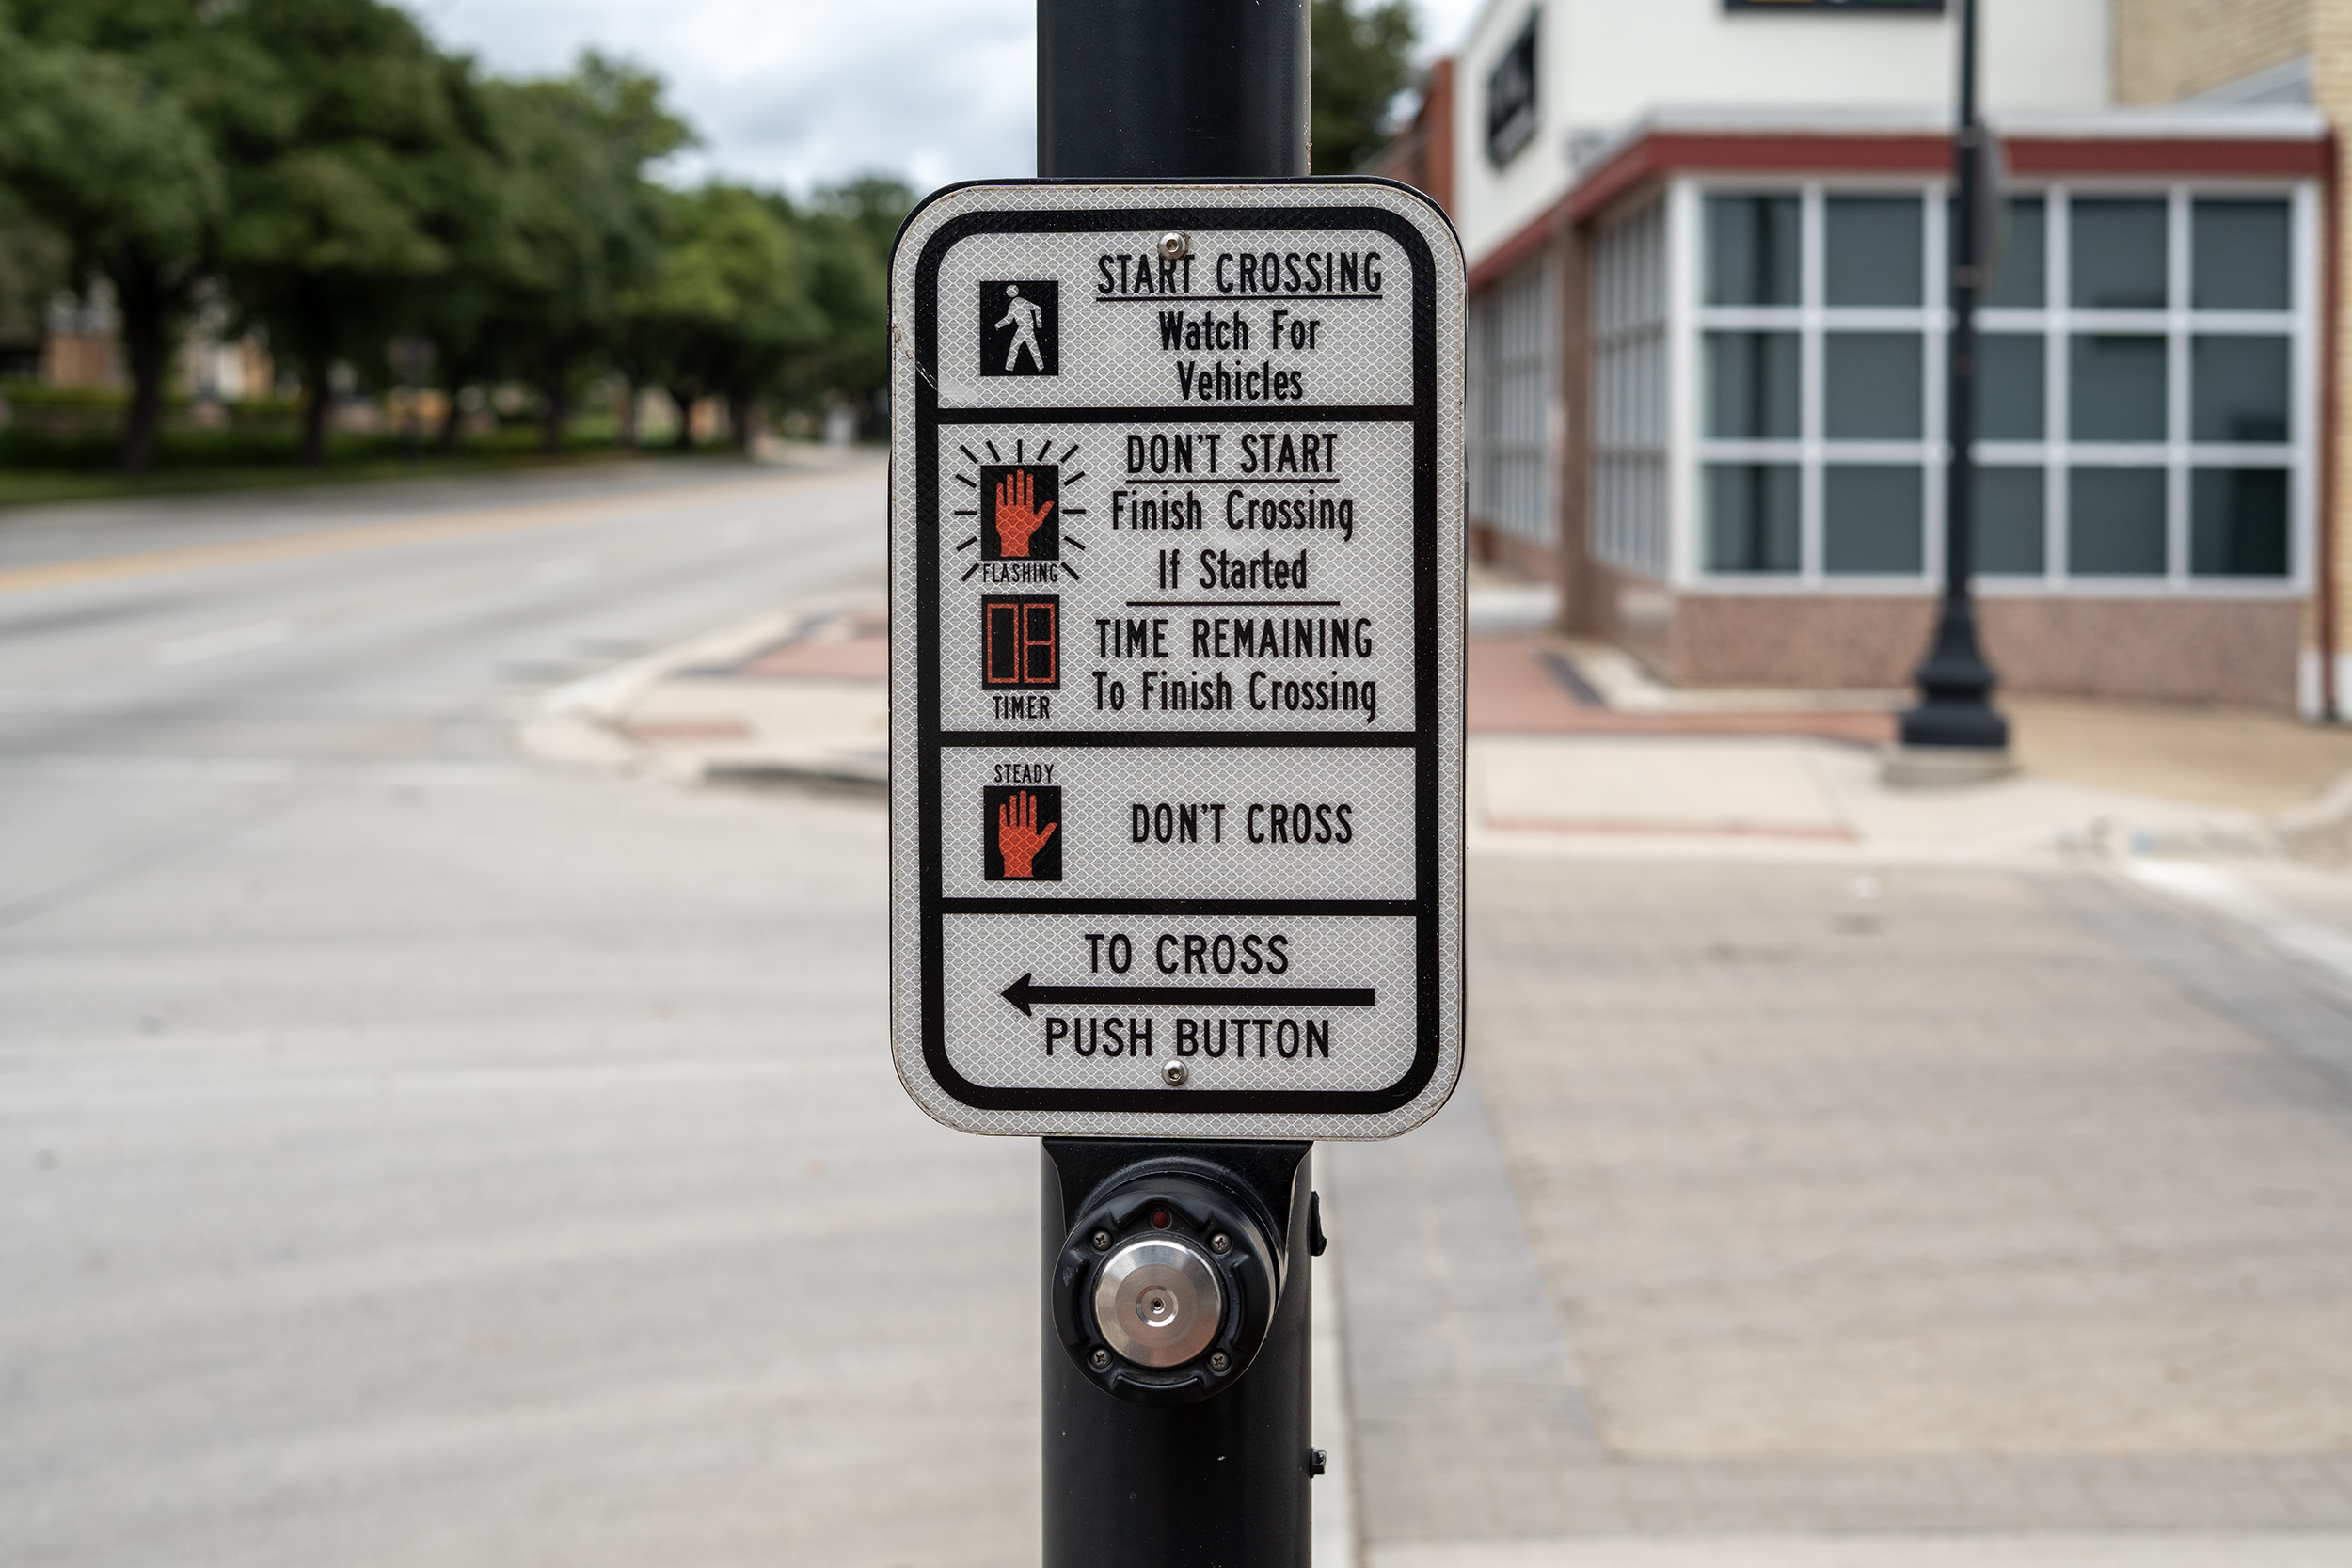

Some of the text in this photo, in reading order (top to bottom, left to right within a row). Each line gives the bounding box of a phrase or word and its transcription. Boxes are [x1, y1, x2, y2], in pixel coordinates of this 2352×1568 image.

[1097, 252, 1382, 294] START CROSSING
[1158, 309, 1321, 351] Watch For
[1176, 359, 1303, 402] Vehicles
[1127, 433, 1338, 474] DON'T START
[1112, 488, 1353, 543] Finish Crossing
[982, 562, 1058, 583] FLASHING
[1159, 548, 1307, 590] If Started
[1095, 617, 1373, 658] TIME REMAINING
[992, 695, 1050, 720] TIMER
[1091, 670, 1376, 724] To Finish Crossing
[993, 763, 1054, 784] STEADY
[1132, 802, 1353, 844] DON'T CROSS
[1084, 933, 1289, 975] TO CROSS
[1045, 1017, 1329, 1059] PUSH BUTTON
